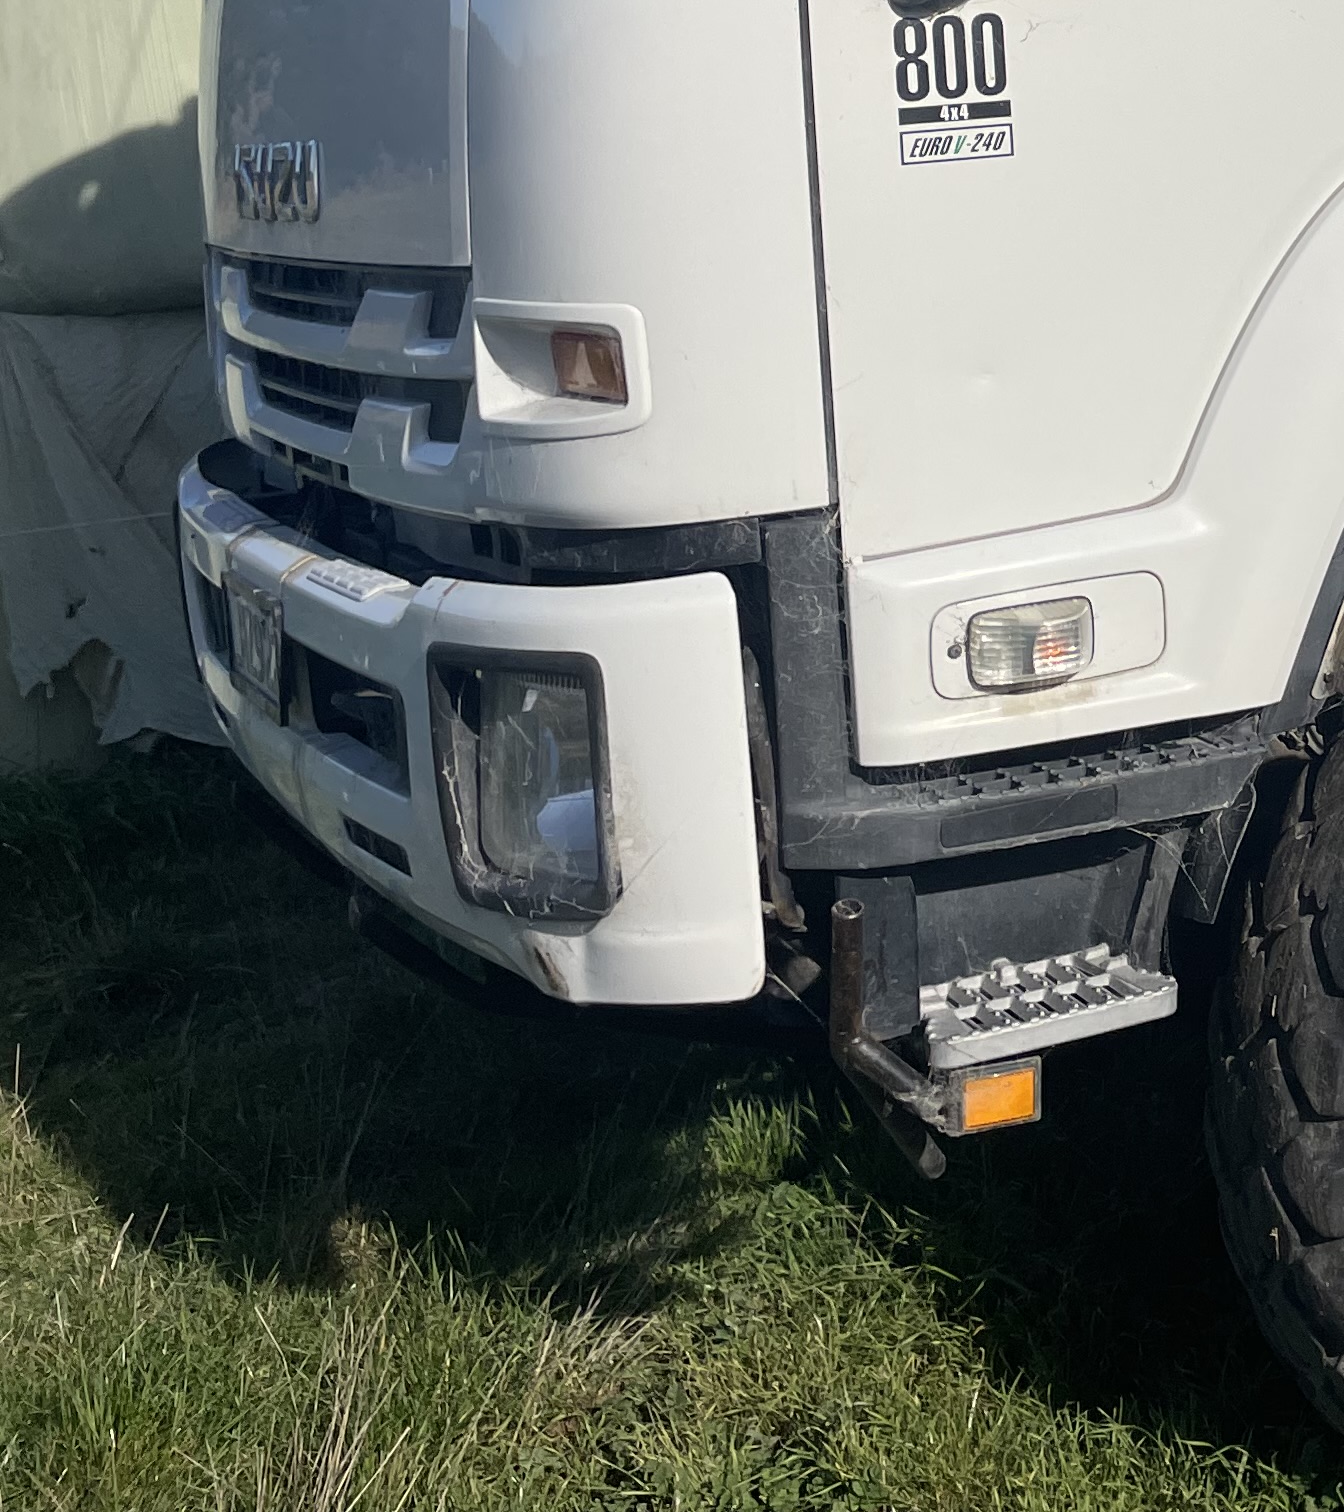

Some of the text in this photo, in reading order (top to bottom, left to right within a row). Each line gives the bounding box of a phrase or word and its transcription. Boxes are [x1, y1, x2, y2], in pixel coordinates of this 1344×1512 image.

[893, 13, 1007, 101] 800
[940, 104, 969, 121] 4x4
[909, 135, 953, 157] EURO
